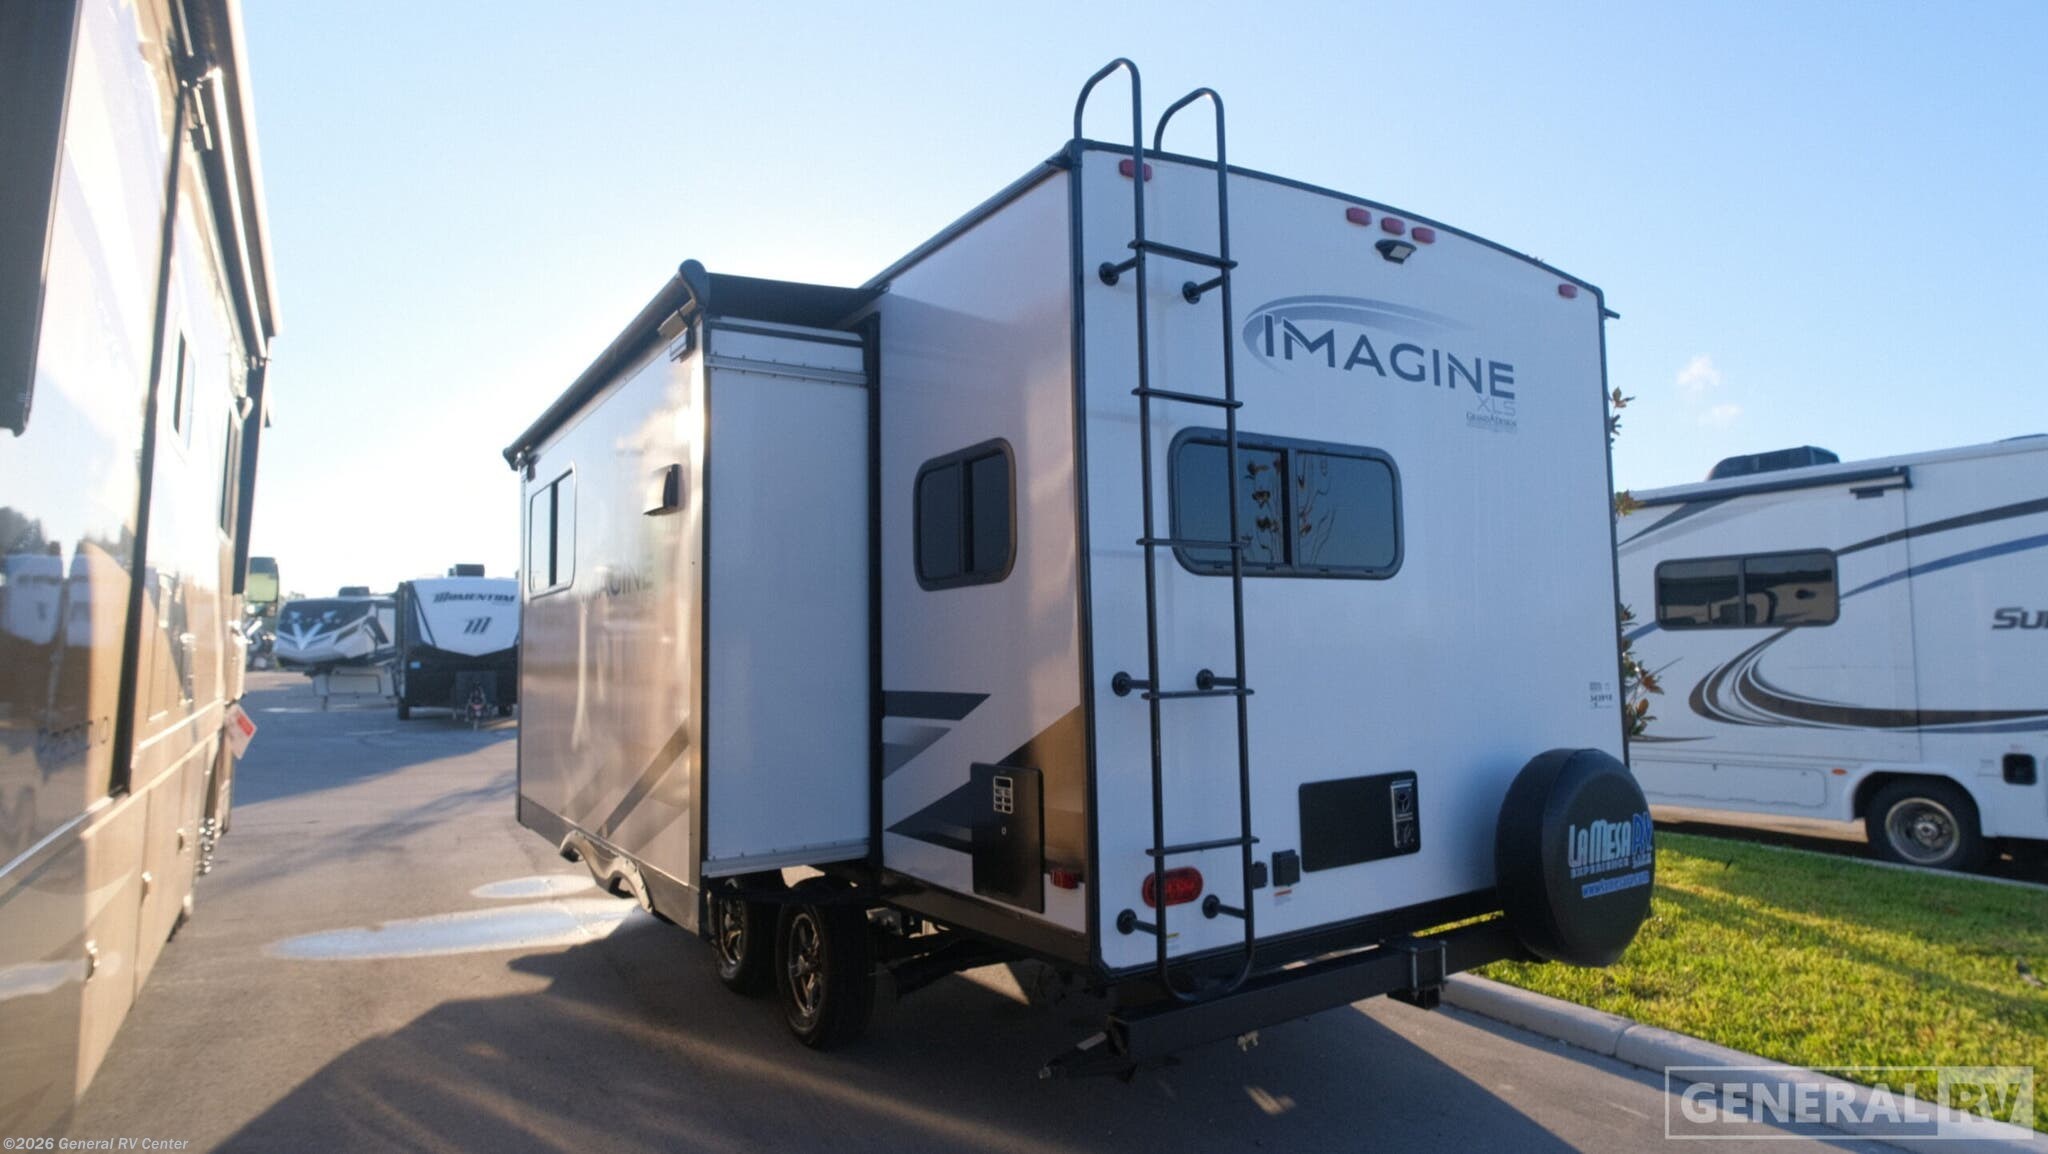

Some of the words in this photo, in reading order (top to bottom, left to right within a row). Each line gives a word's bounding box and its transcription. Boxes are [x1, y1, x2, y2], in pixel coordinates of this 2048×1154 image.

[1264, 313, 1515, 400] IMAGINE
[1476, 395, 1517, 417] XLS
[1991, 606, 2048, 630] SU
